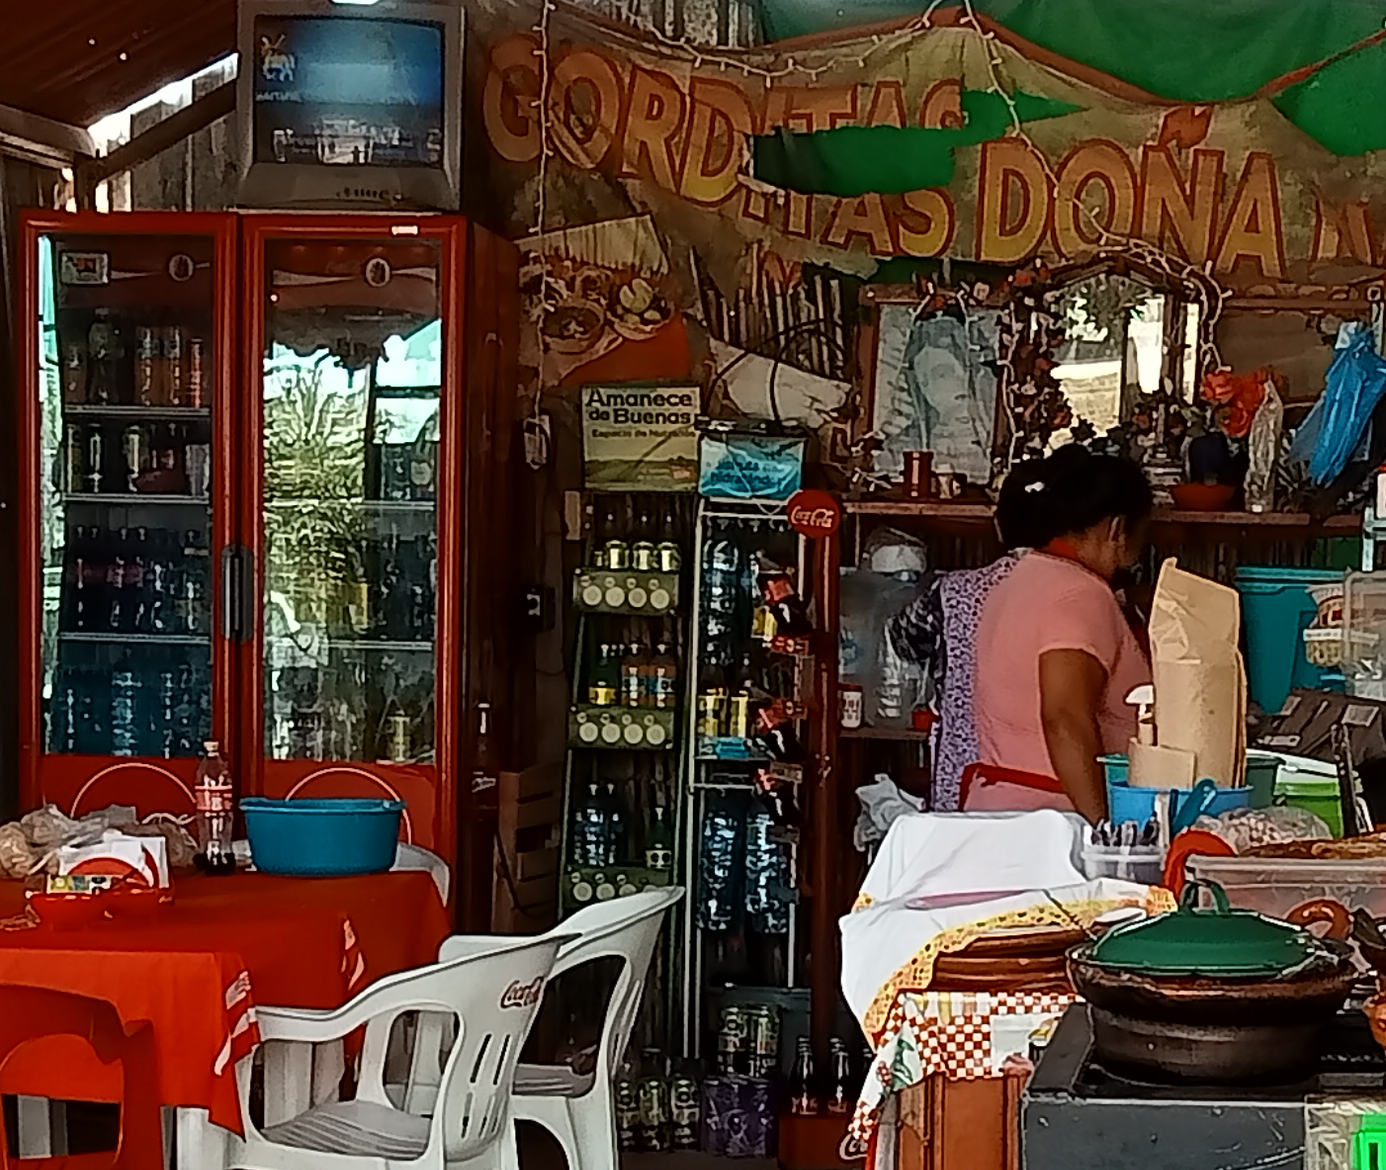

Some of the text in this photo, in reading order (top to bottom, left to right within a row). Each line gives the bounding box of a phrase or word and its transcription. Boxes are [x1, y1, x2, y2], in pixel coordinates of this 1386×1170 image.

[977, 107, 1287, 280] DOÑA
[585, 388, 693, 407] Amanece
[613, 408, 692, 425] Buenas
